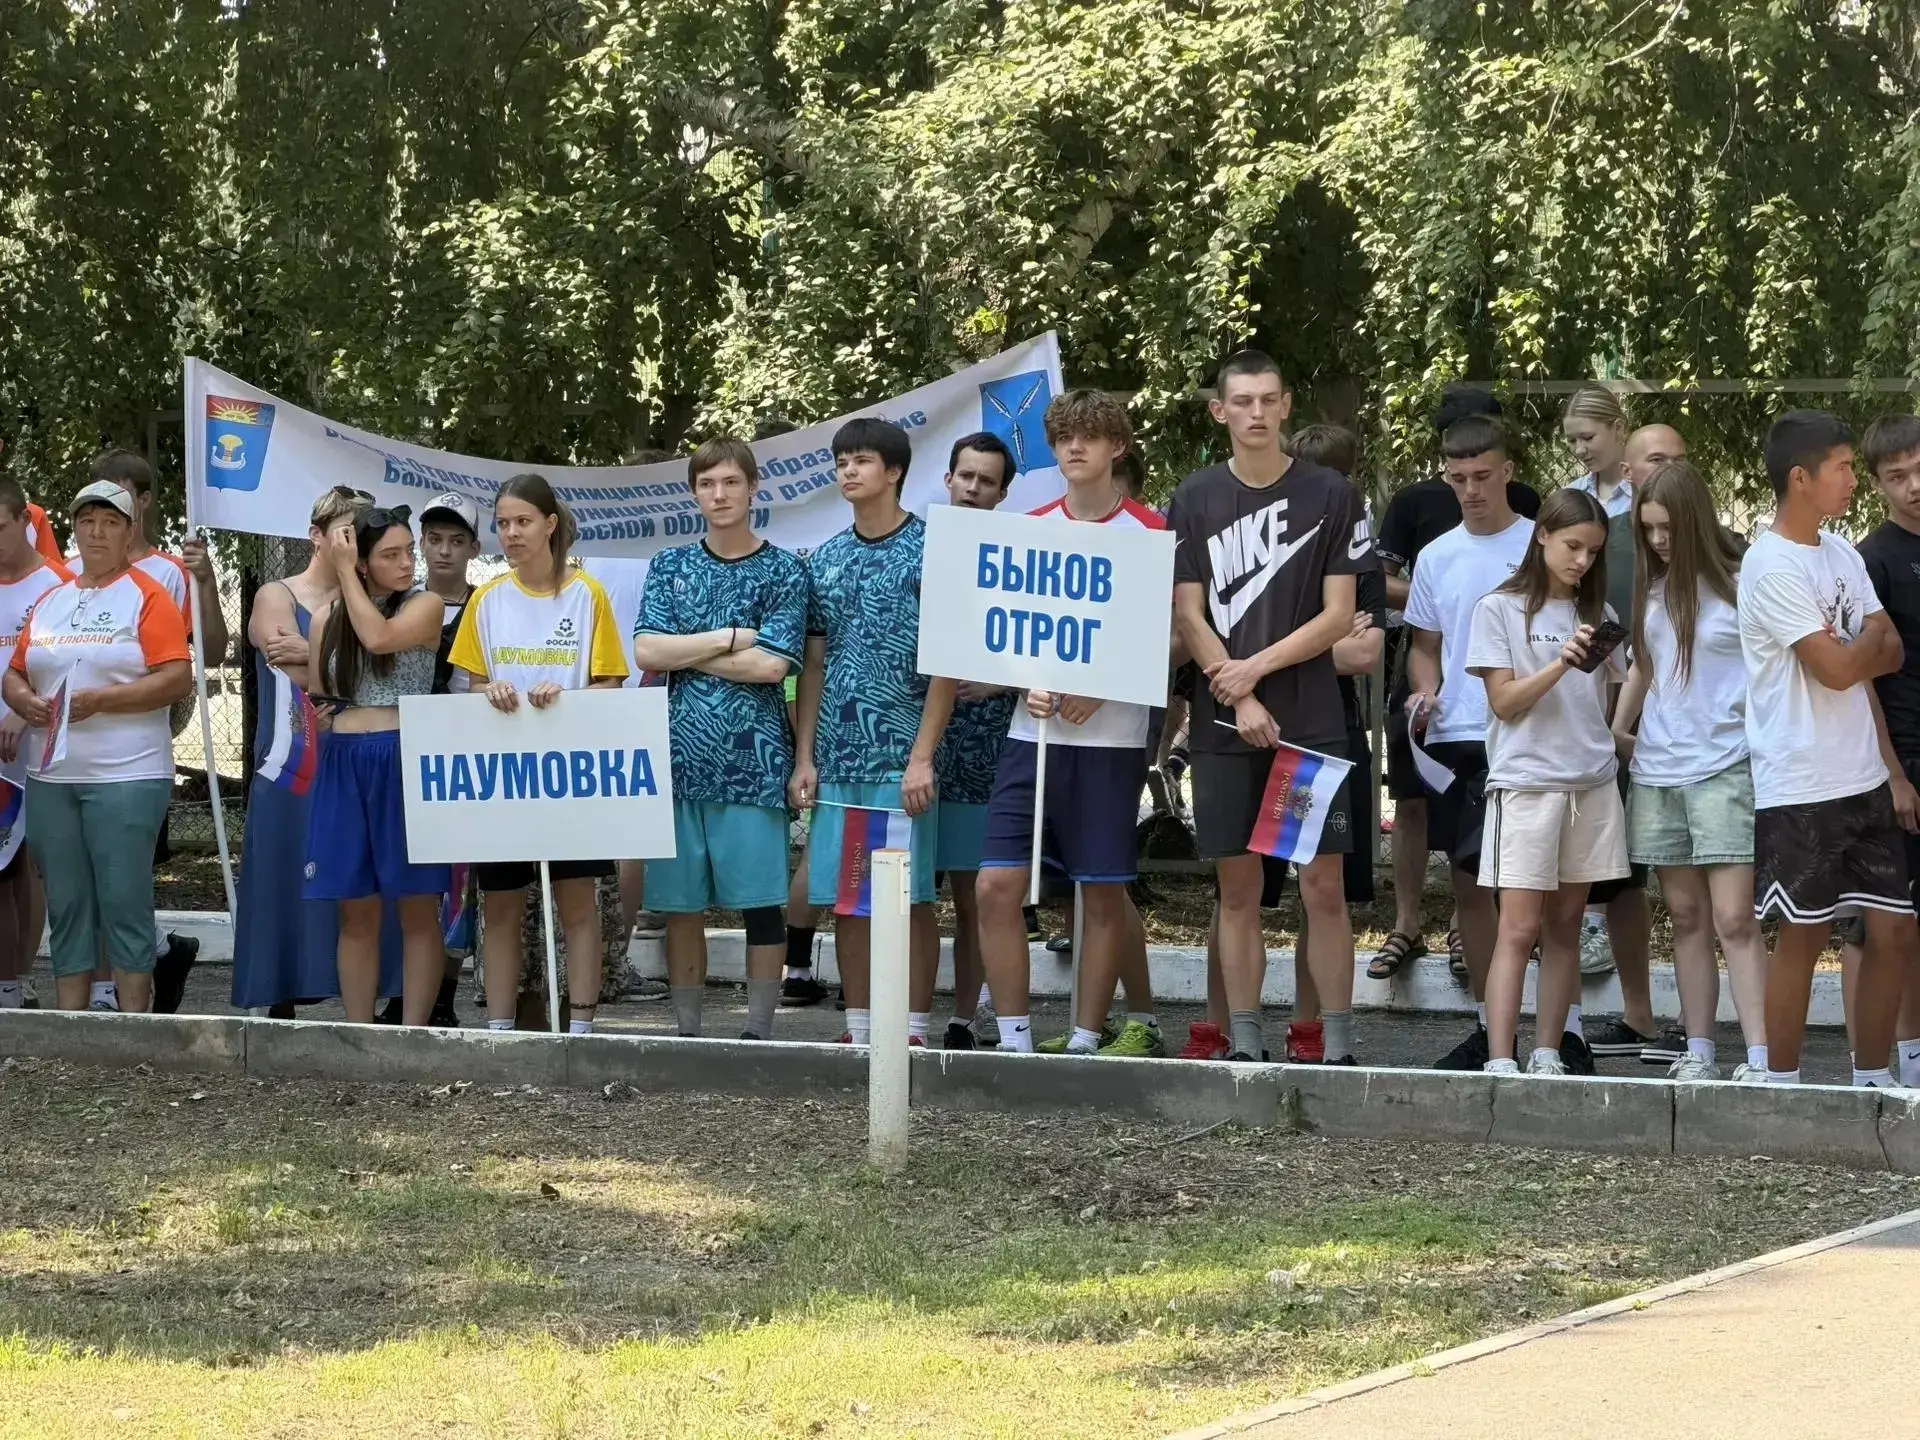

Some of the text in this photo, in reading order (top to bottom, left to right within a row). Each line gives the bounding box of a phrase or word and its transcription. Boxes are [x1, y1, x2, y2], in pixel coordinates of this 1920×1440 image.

[977, 543, 1113, 604] БЫКОВ
[1207, 498, 1289, 593] NIKE
[985, 606, 1102, 665] ОТРОГ
[419, 748, 658, 802] НАУМОВКА
